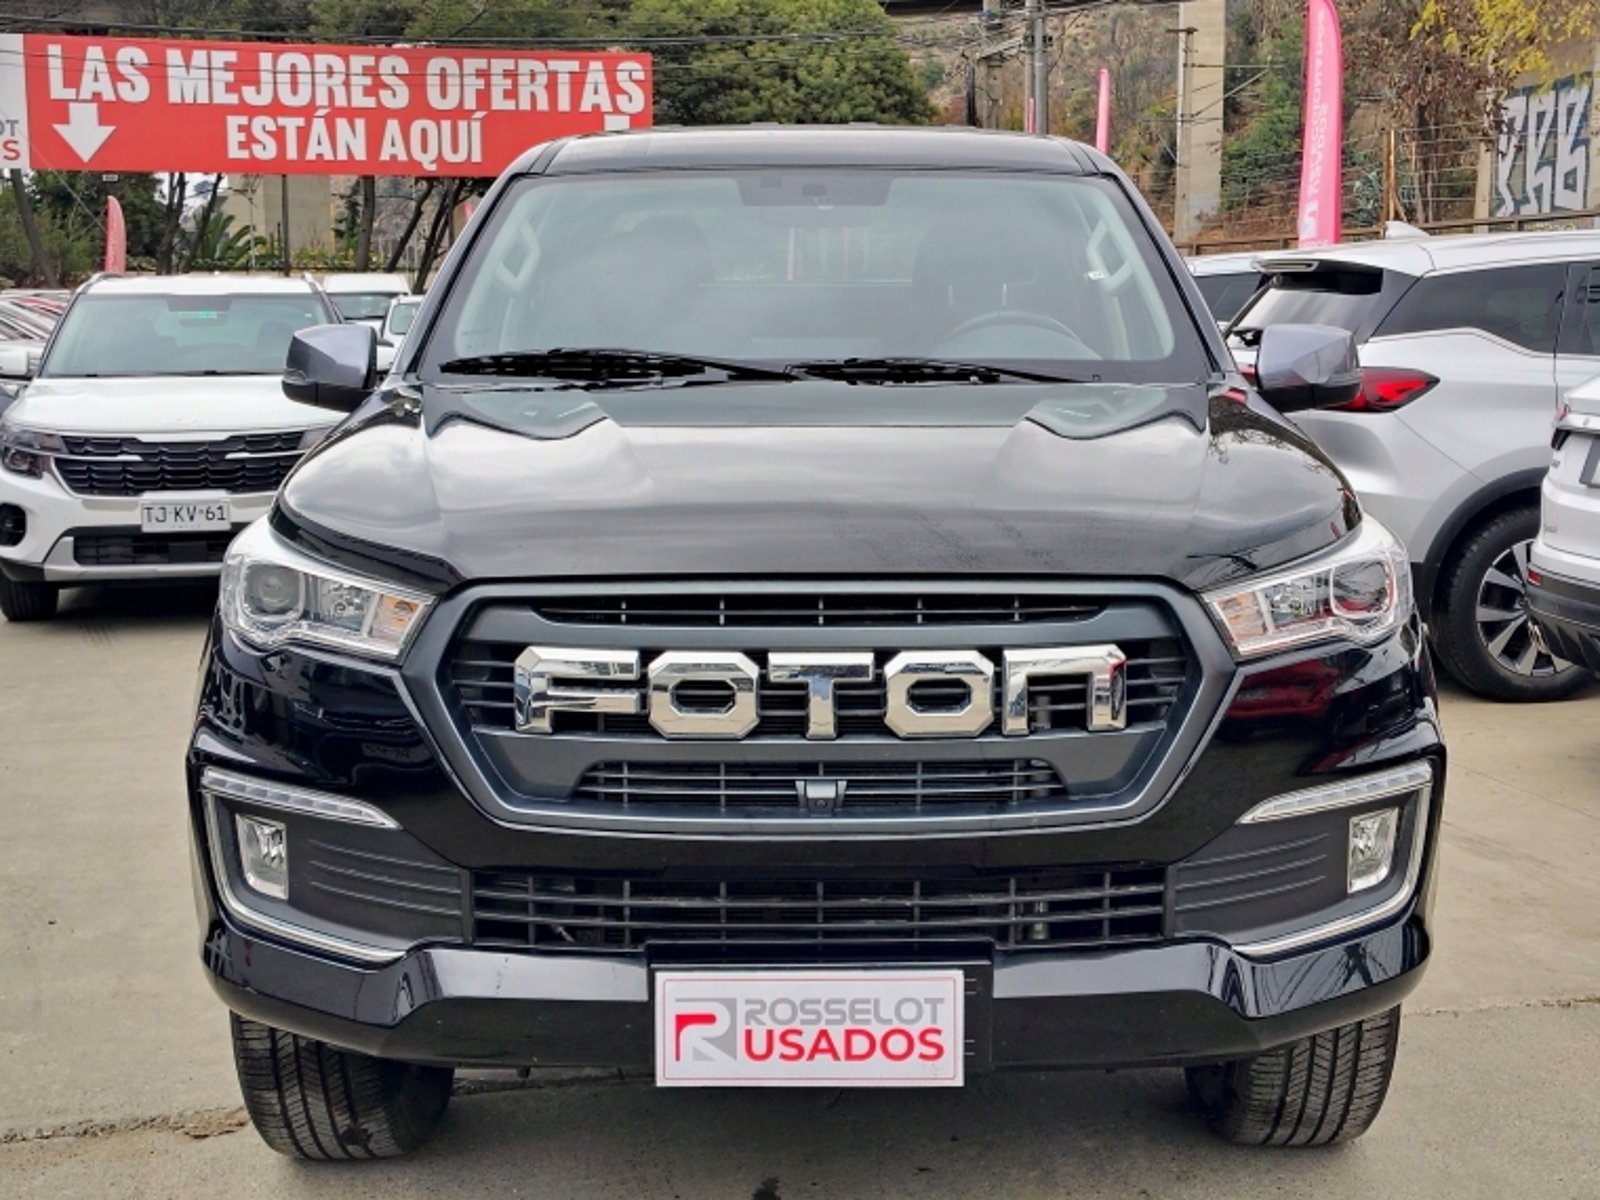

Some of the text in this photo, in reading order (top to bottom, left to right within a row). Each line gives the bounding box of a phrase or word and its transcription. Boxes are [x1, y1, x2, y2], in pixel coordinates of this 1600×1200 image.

[48, 44, 646, 115] LAS MEJORES OFERTAS
[226, 108, 487, 171] ESTÁN AQUÍ
[744, 997, 945, 1026] ROSSELOT
[744, 1028, 945, 1062] USADOS
